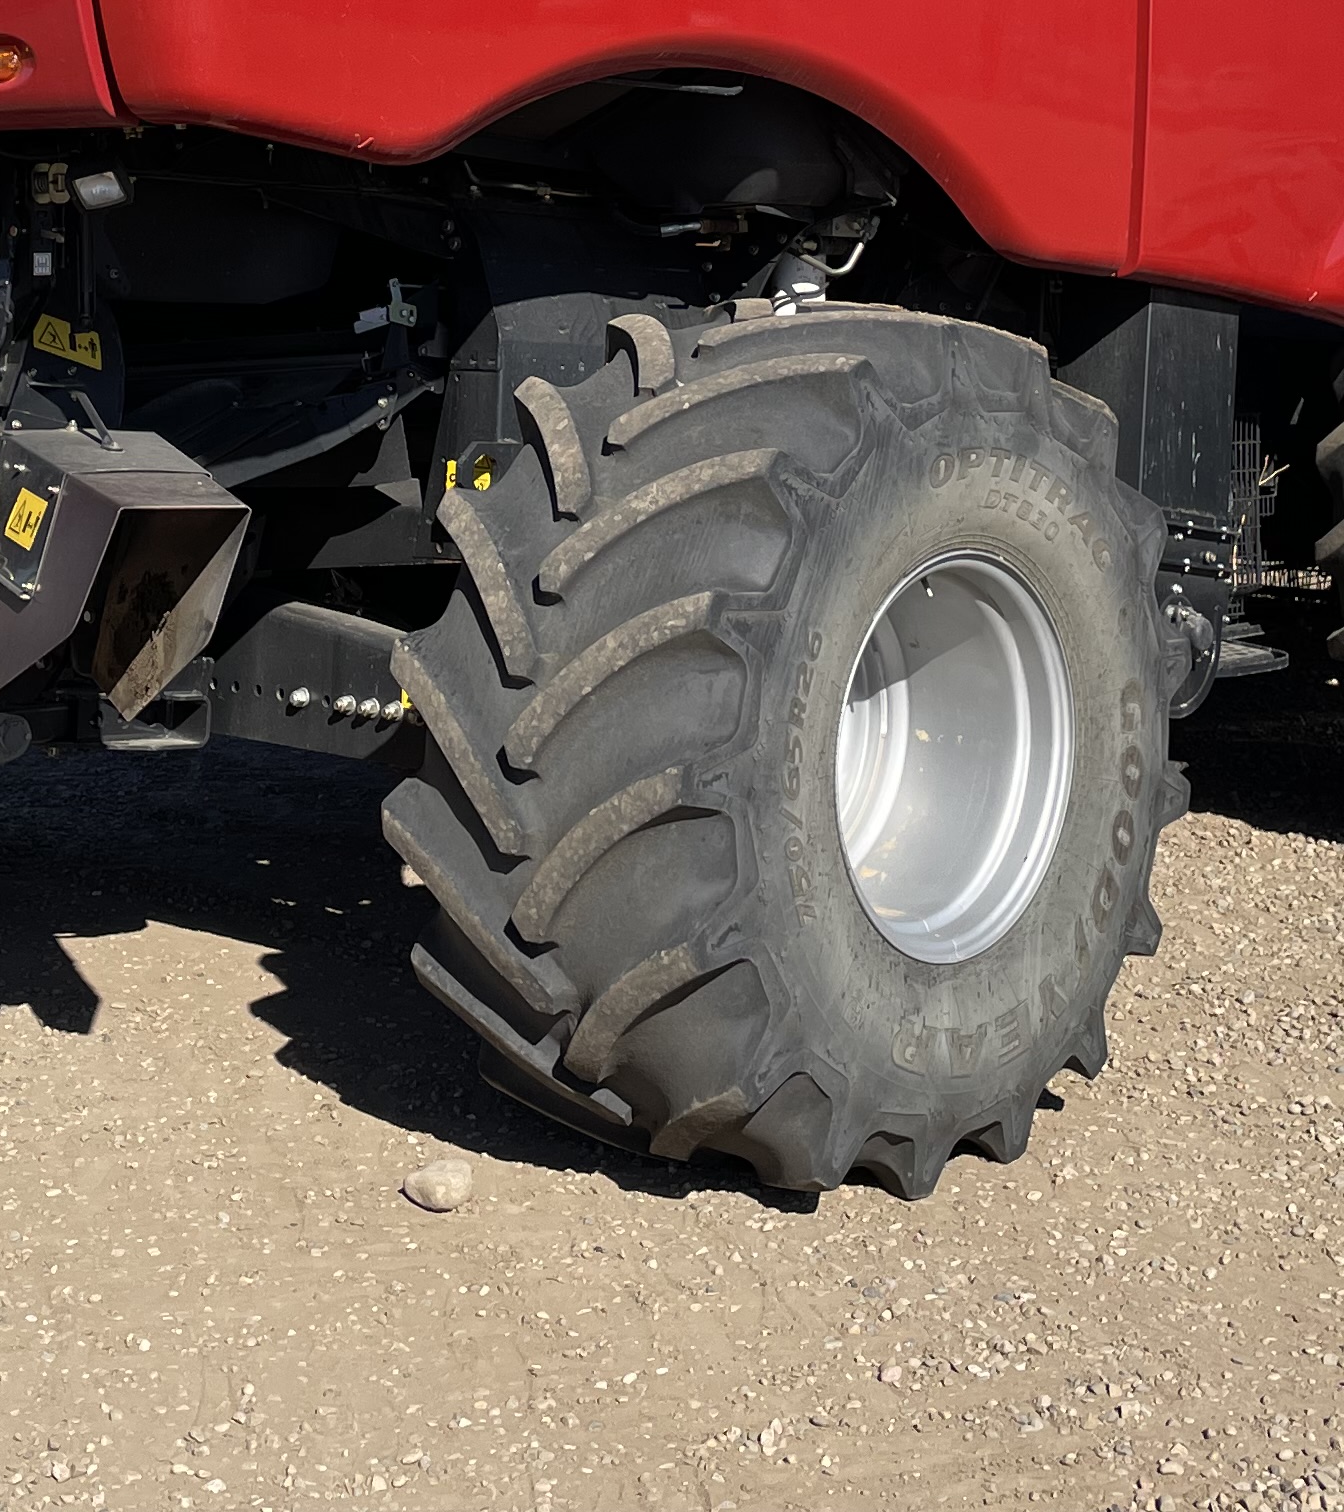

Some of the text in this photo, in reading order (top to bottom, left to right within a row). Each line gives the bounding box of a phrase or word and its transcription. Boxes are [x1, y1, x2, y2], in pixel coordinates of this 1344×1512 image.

[929, 446, 1114, 573] OPTITRAC
[982, 488, 1061, 545] DT830
[781, 629, 825, 929] 750/65R26
